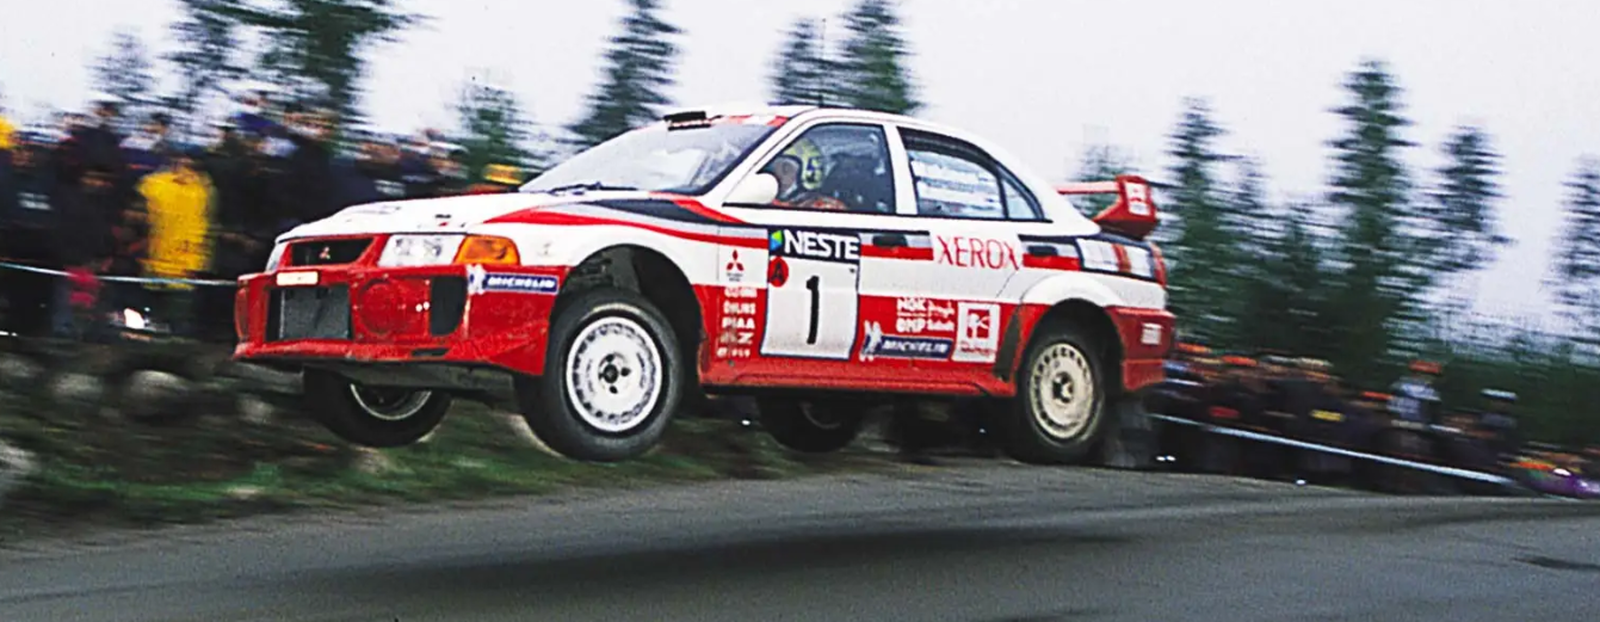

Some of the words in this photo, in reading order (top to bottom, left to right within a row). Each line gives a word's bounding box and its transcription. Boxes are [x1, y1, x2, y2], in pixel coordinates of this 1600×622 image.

[784, 229, 861, 259] NESTE
[937, 235, 1020, 271] XEROX
[771, 261, 786, 284] A
[722, 317, 755, 330] PIAA
[806, 275, 820, 345] 1
